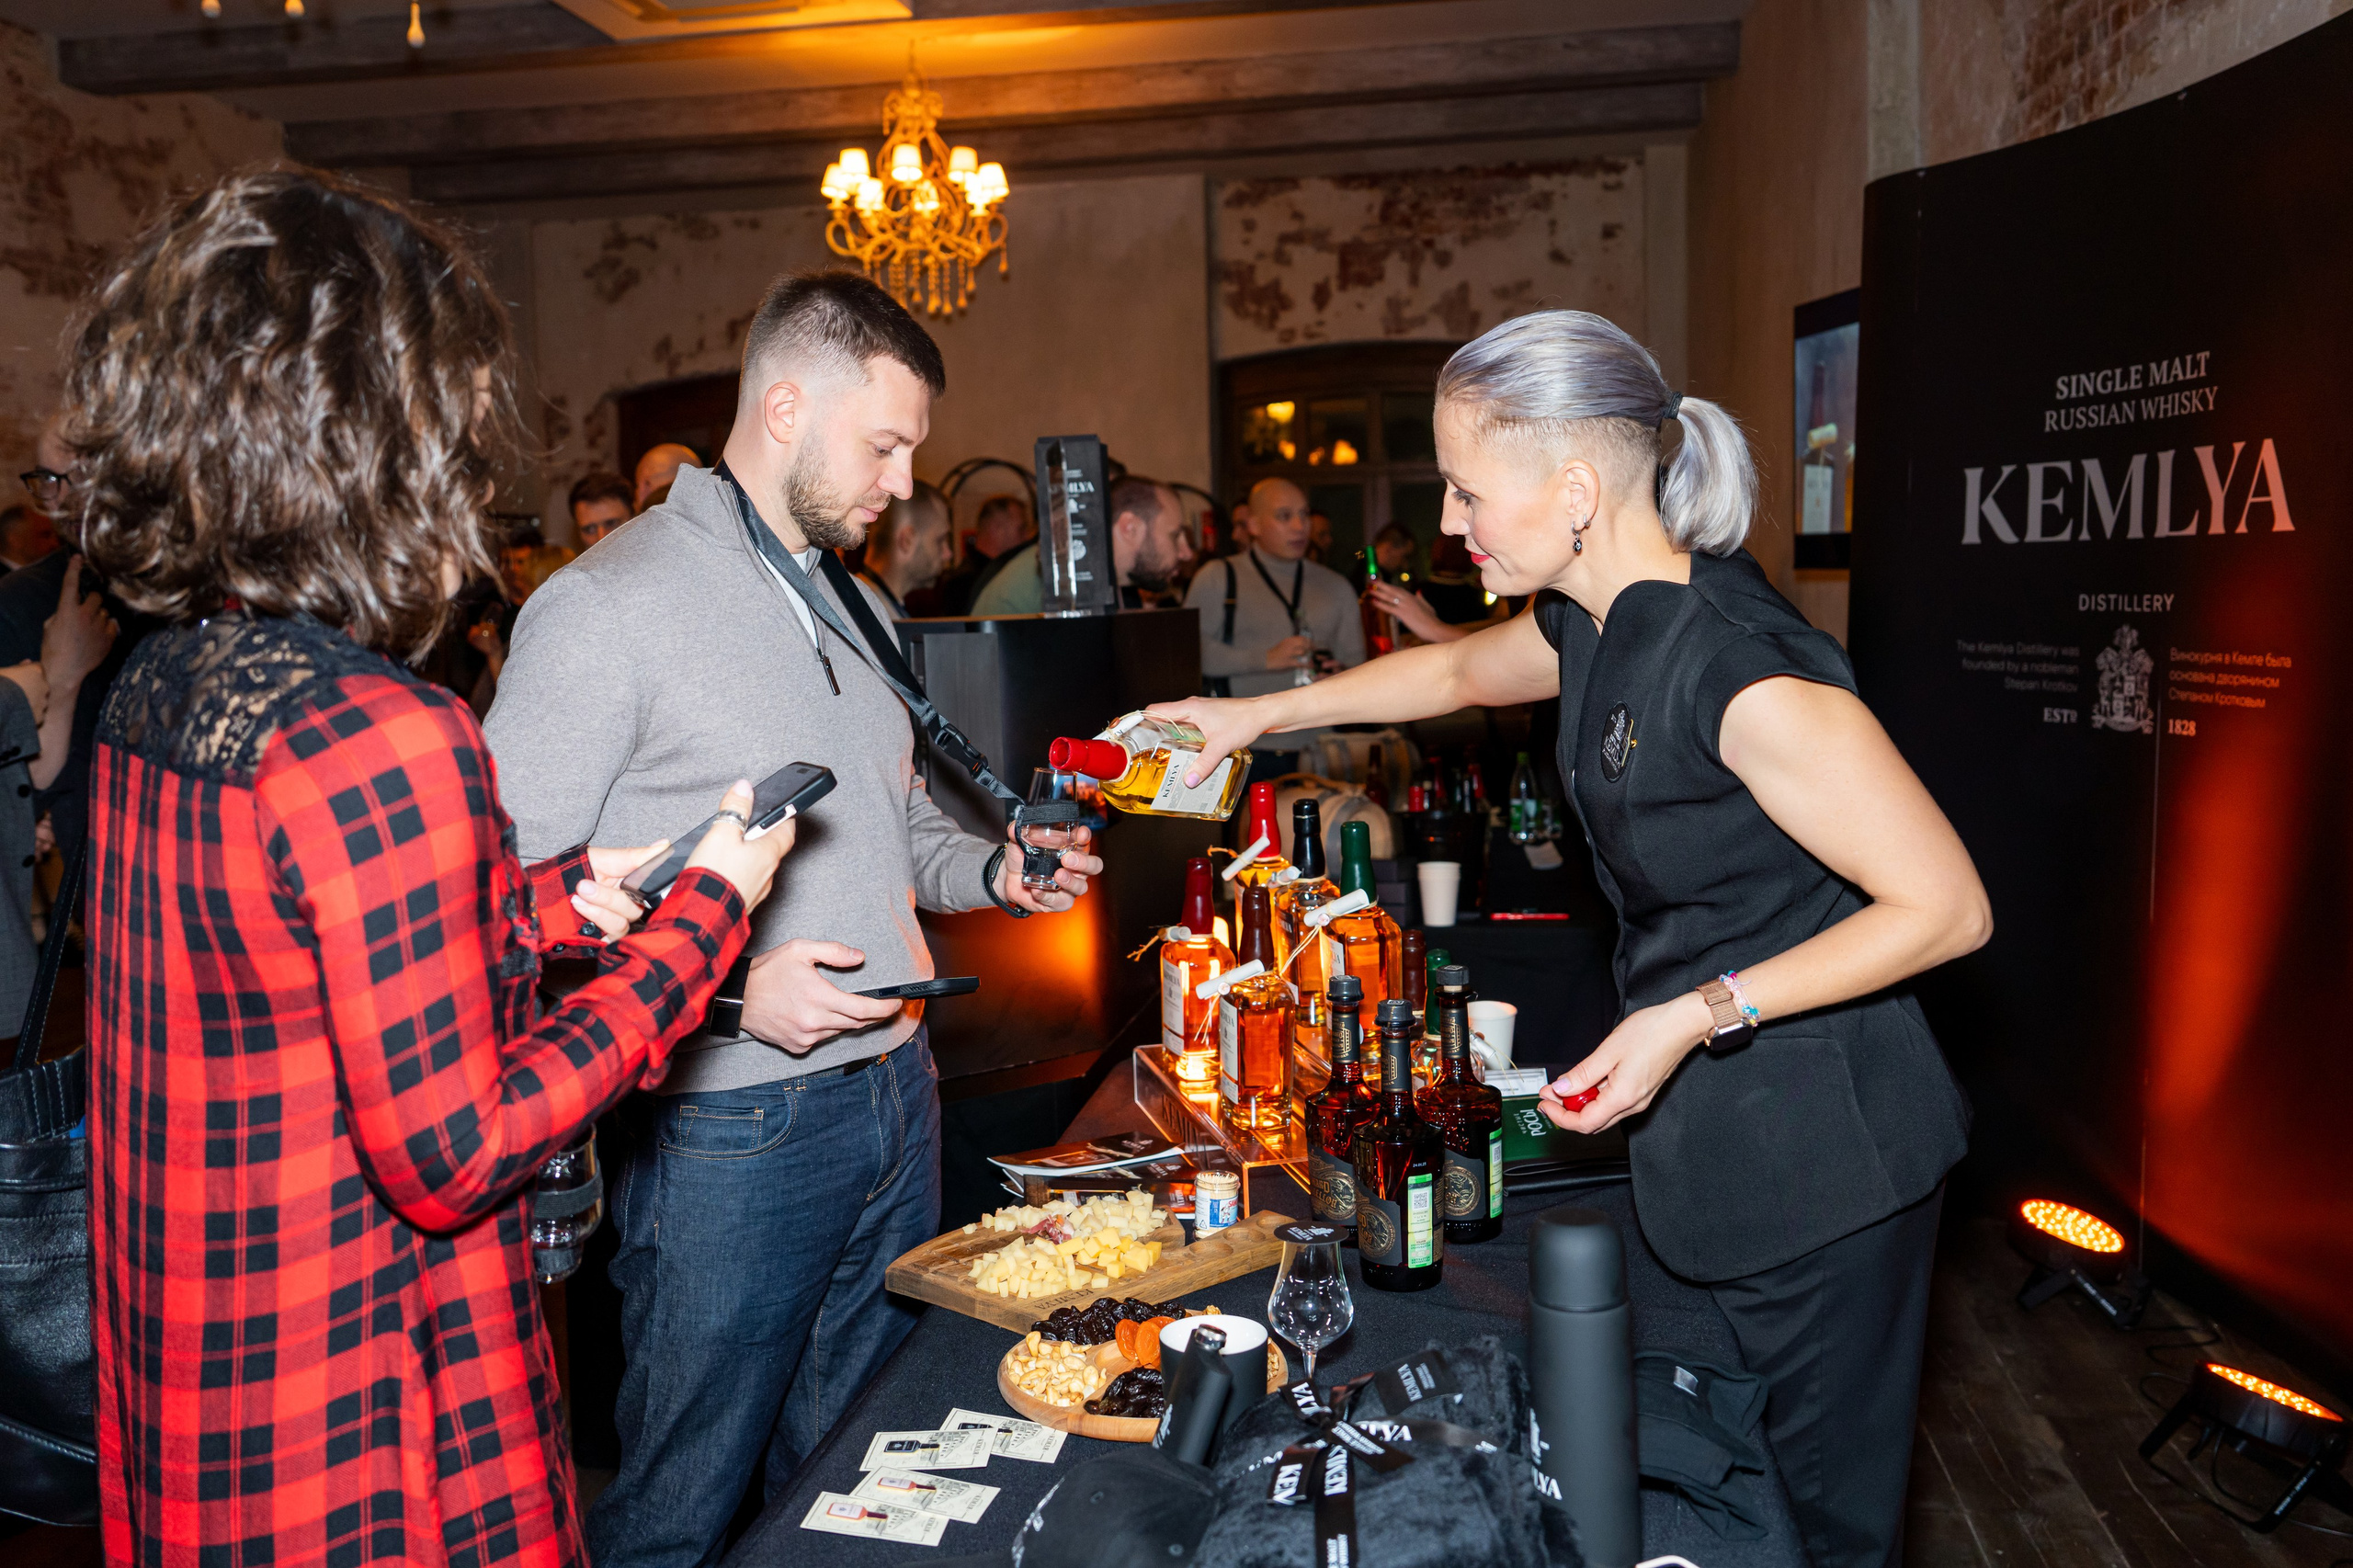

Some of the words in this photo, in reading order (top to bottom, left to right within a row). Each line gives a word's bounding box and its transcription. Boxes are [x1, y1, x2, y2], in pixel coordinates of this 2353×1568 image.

[2055, 364, 2143, 400] SINGLE
[2148, 350, 2211, 386] MALT
[2043, 400, 2136, 433] RUSSIAN
[2140, 385, 2219, 420] WHISKY
[1961, 437, 2295, 545] KEMLYA
[2078, 593, 2175, 612] DISTILLERY
[2168, 718, 2197, 736] 1828
[1162, 764, 1180, 798] KEMLYA
[1519, 1108, 1547, 1137] РОСЫ
[1324, 1444, 1348, 1496] KEMLY
